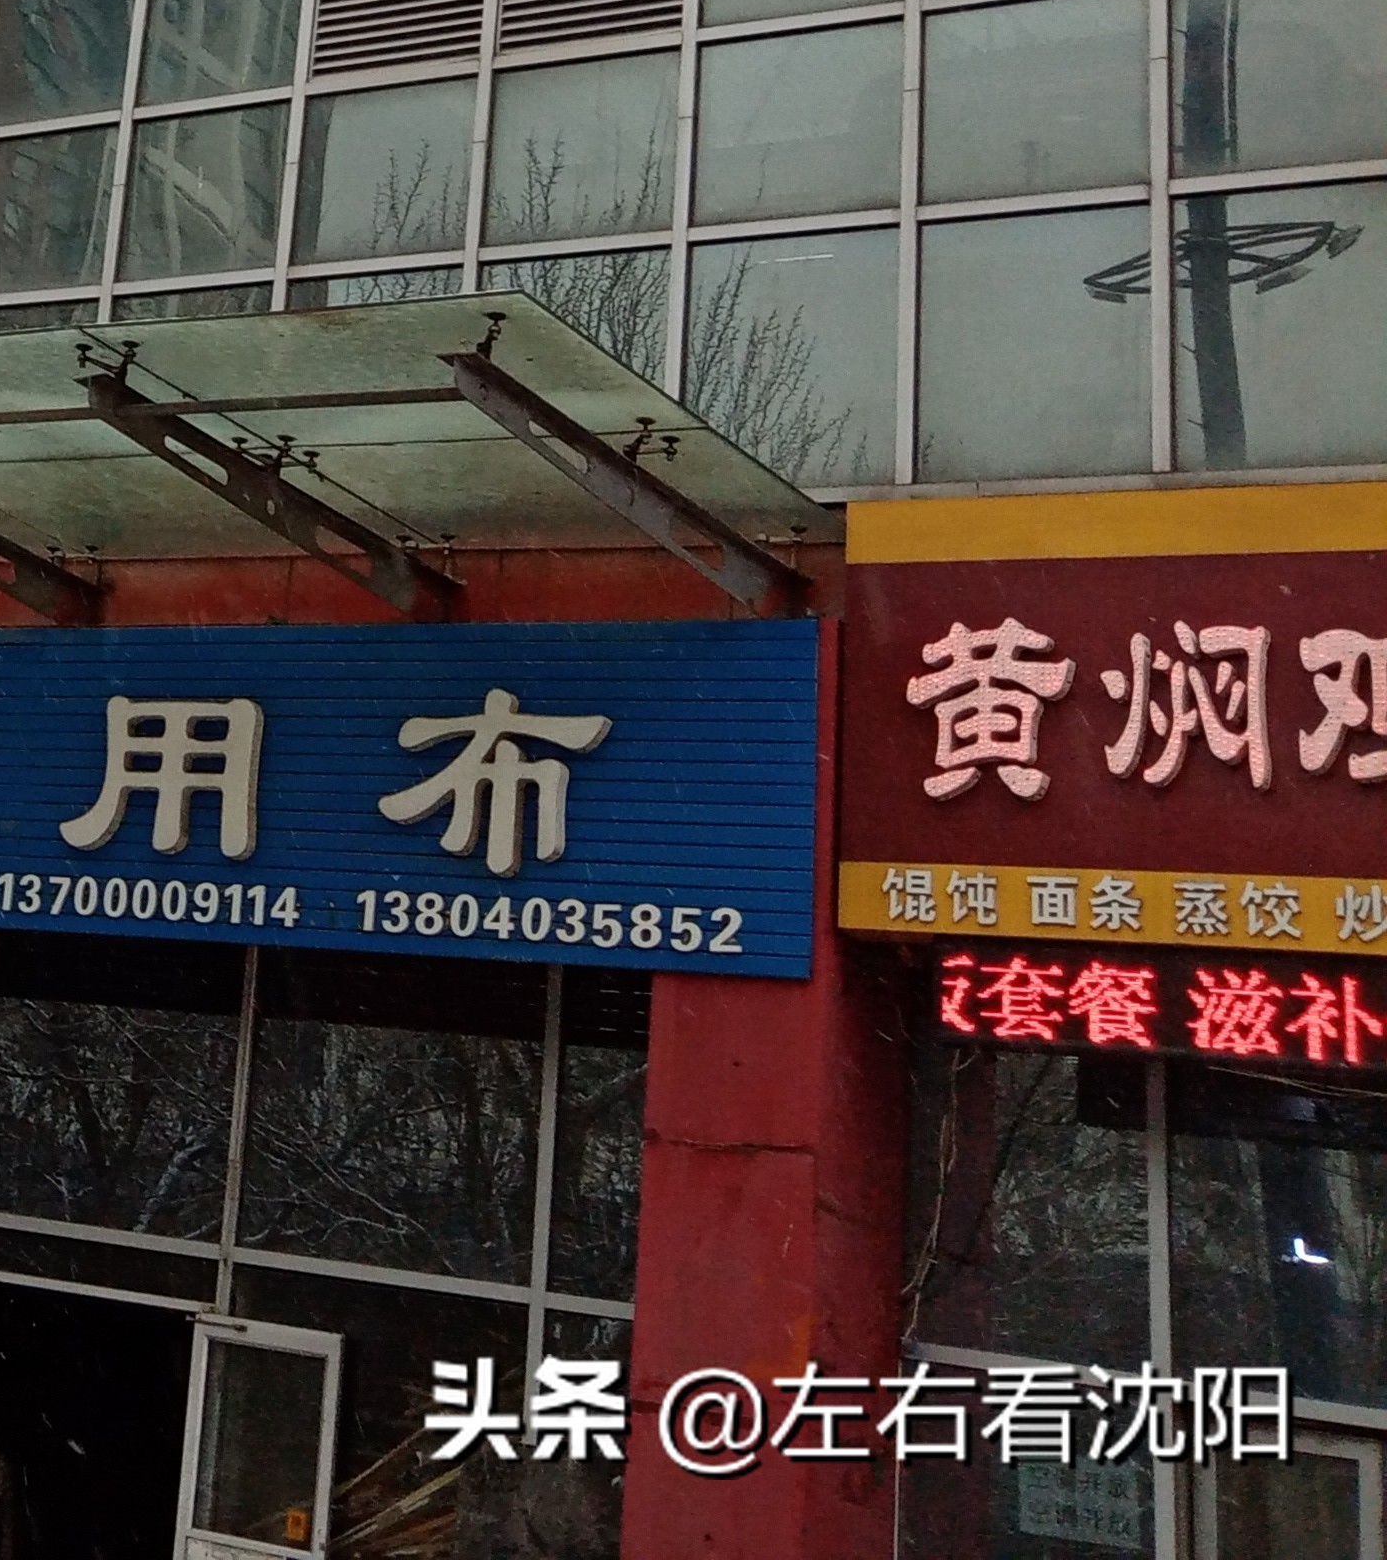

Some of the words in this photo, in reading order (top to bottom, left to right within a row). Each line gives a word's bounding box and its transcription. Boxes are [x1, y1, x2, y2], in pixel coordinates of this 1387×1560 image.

[355, 889, 744, 954] 13804035852
[882, 868, 998, 927] 馄饨
[1027, 874, 1143, 931] 面条
[1174, 879, 1303, 939] 蒸饺
[1186, 967, 1386, 1065] 滋补
